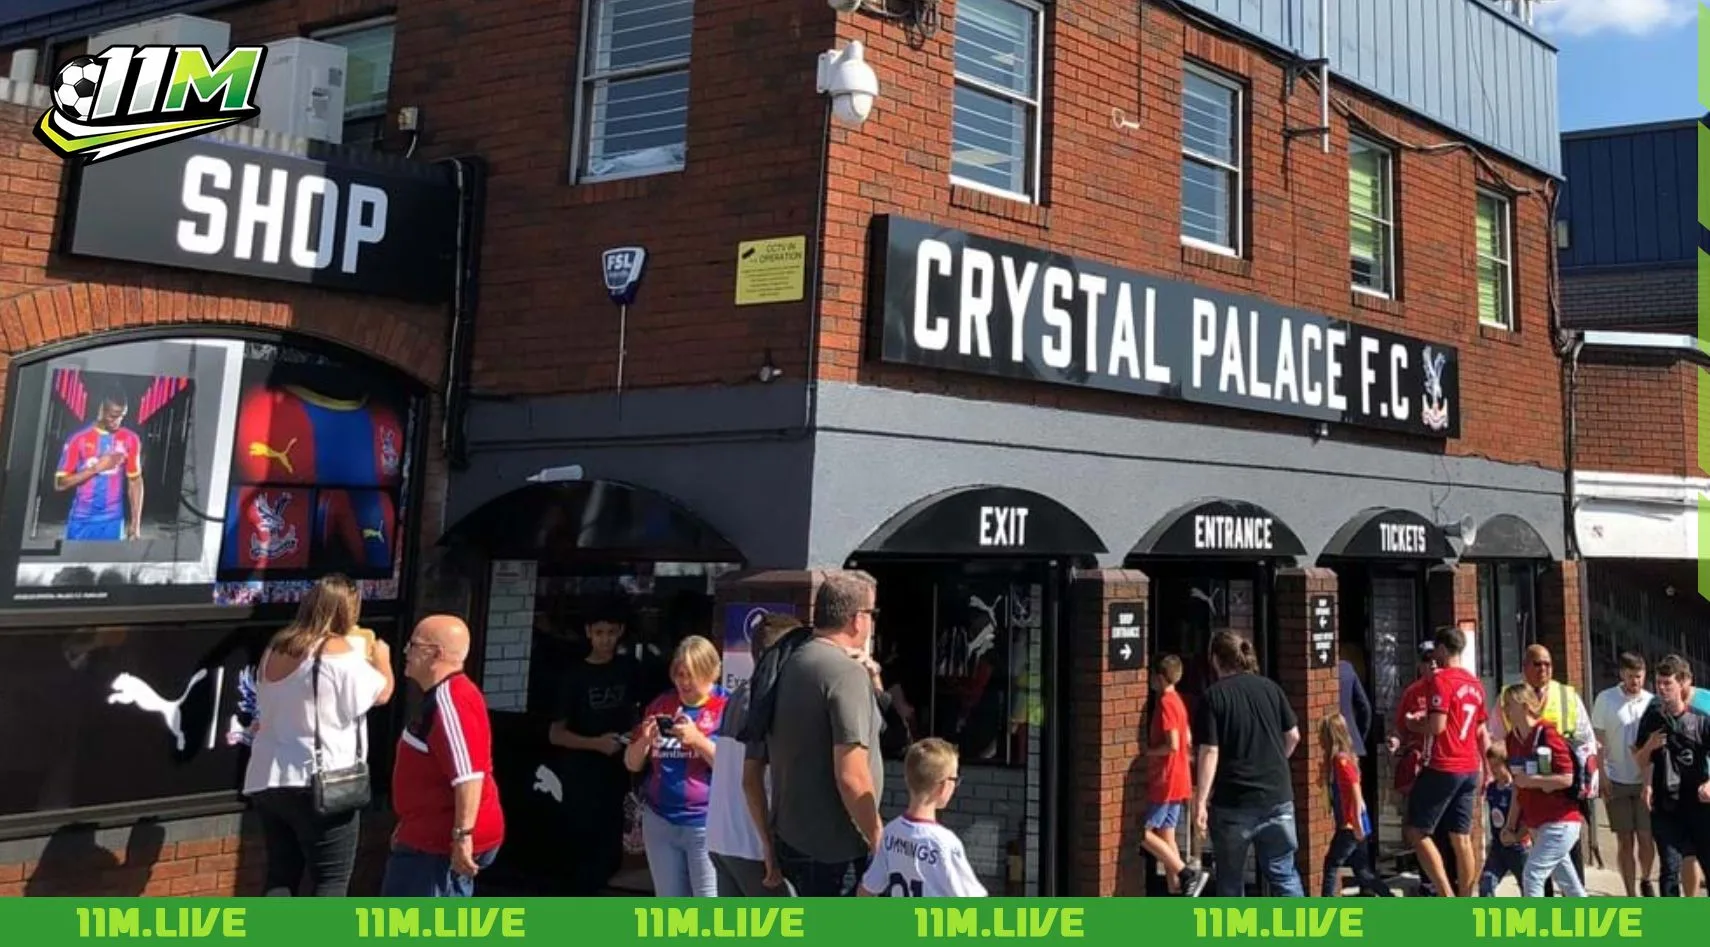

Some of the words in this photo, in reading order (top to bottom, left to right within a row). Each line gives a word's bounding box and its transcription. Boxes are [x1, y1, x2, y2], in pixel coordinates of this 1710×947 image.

[176, 154, 388, 273] SHOP
[607, 253, 632, 270] FSL
[913, 238, 1171, 384] CRYSTAL
[1192, 298, 1347, 411] PALACE
[1361, 336, 1409, 420] F.C
[979, 506, 1029, 546] EXIT
[1194, 514, 1273, 550] ENTRANCE
[1379, 522, 1426, 553] TICKETS
[1459, 703, 1476, 740] 7
[884, 834, 939, 865] UMMINGS
